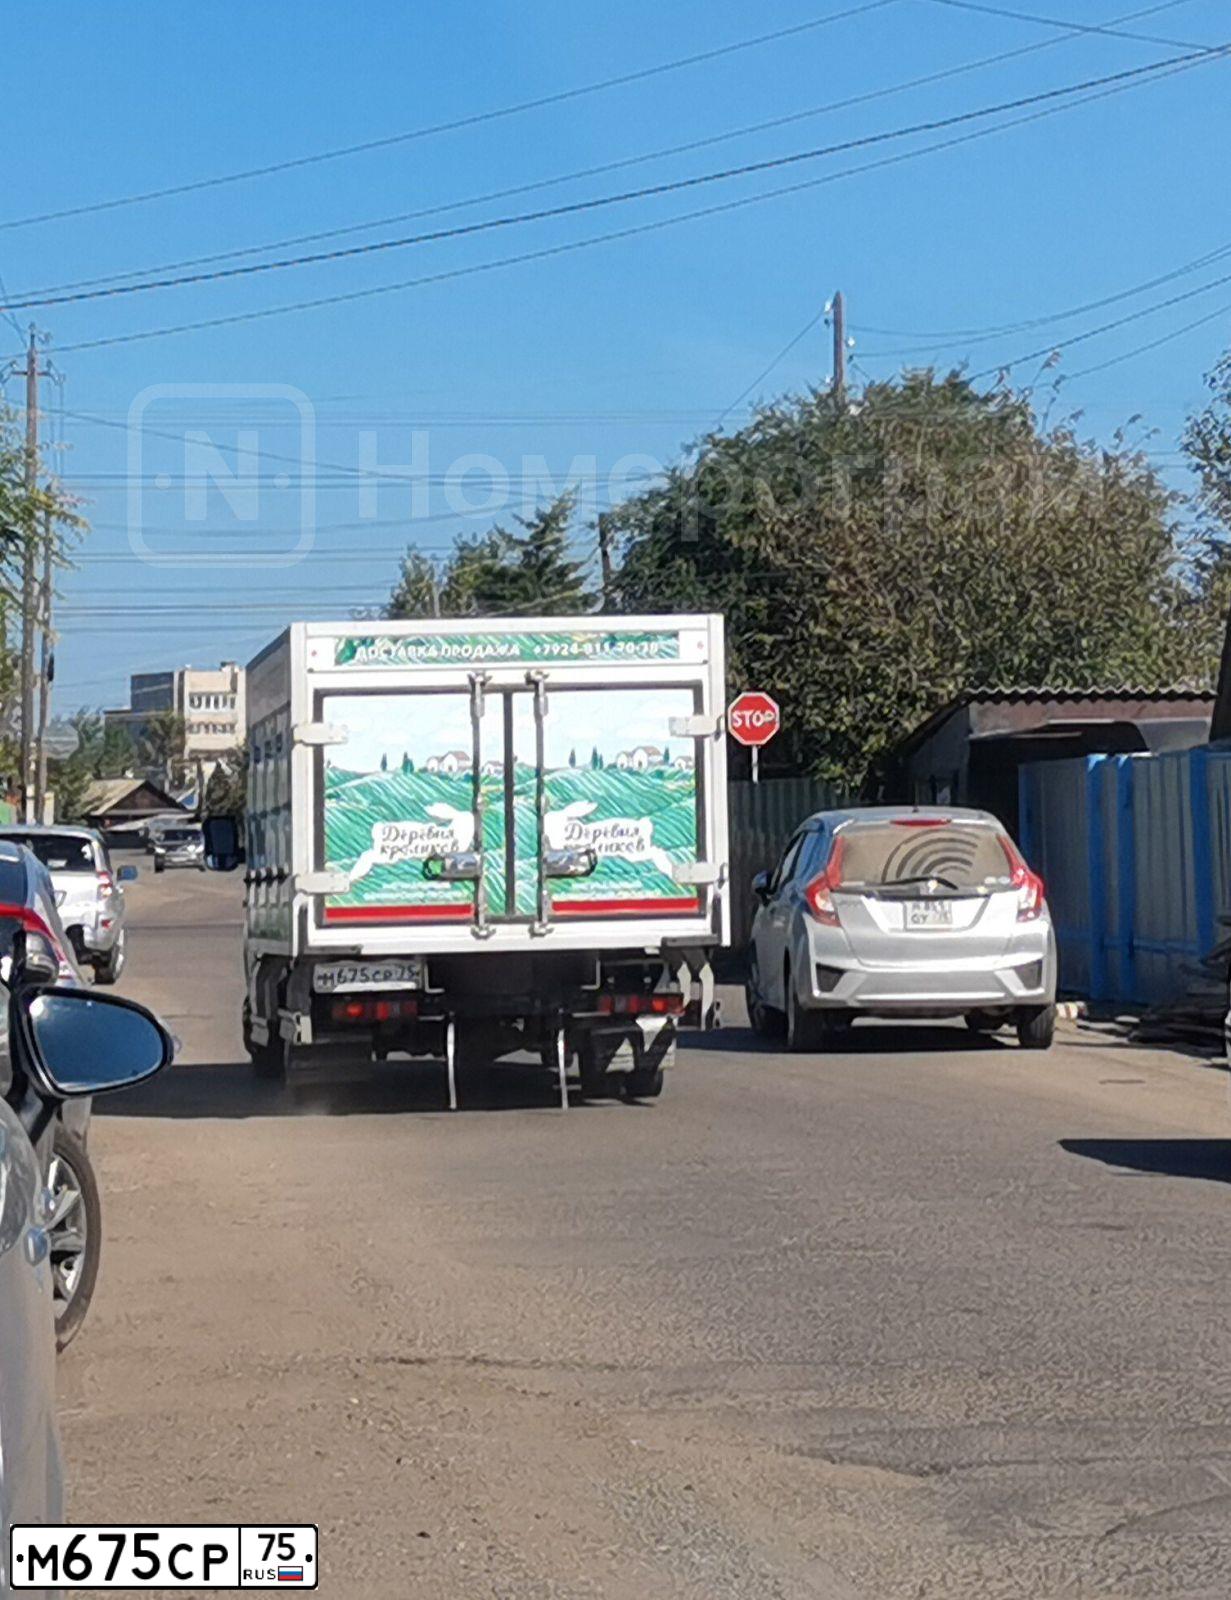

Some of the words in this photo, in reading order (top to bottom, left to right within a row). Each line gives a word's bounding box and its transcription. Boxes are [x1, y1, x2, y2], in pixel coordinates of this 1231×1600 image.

[732, 709, 776, 729] STOP
[382, 825, 454, 845] Деревня
[564, 822, 640, 843] Деревня
